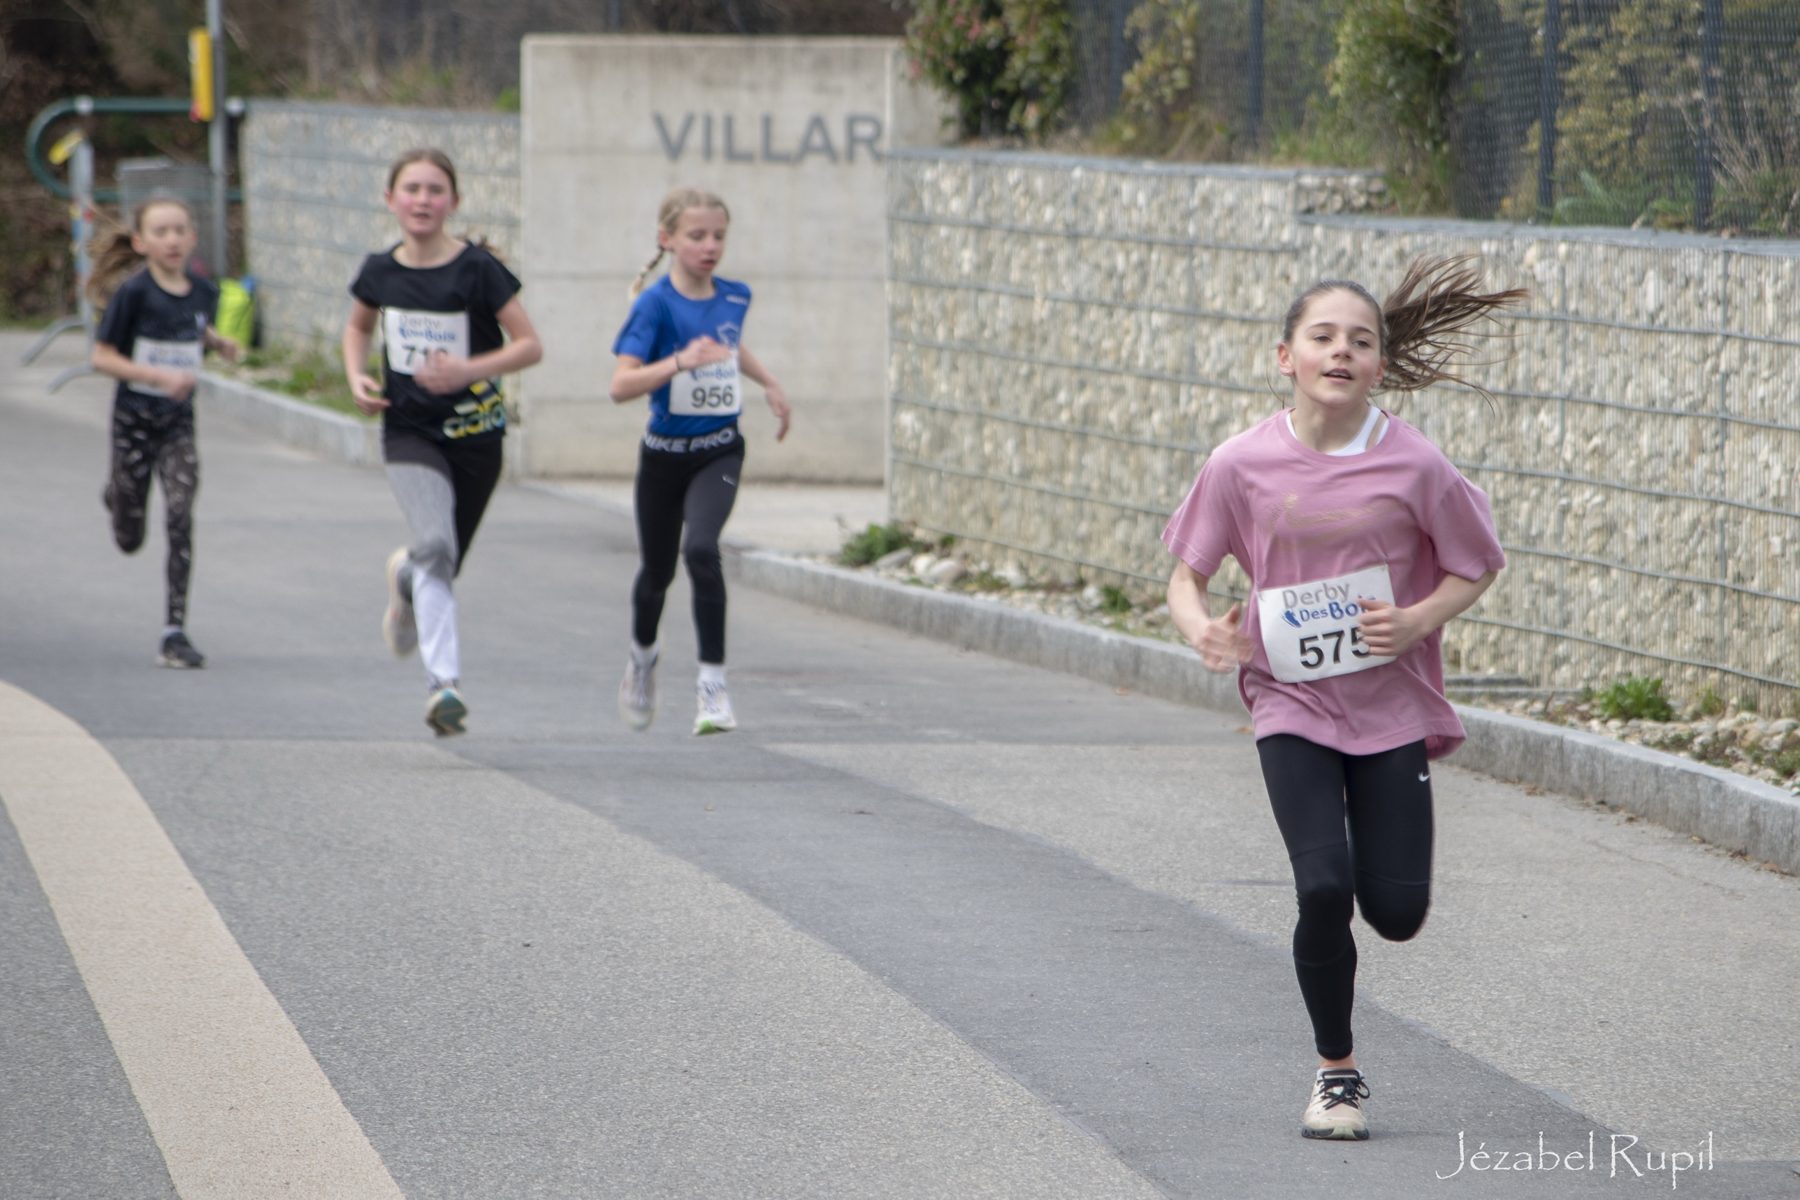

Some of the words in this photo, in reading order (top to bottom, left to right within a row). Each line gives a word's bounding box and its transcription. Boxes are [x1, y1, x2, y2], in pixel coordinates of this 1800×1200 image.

[652, 111, 884, 163] VILLAR
[690, 385, 735, 409] 956
[688, 428, 735, 452] PRO
[1282, 582, 1350, 609] Derby
[1298, 626, 1371, 669] 575
